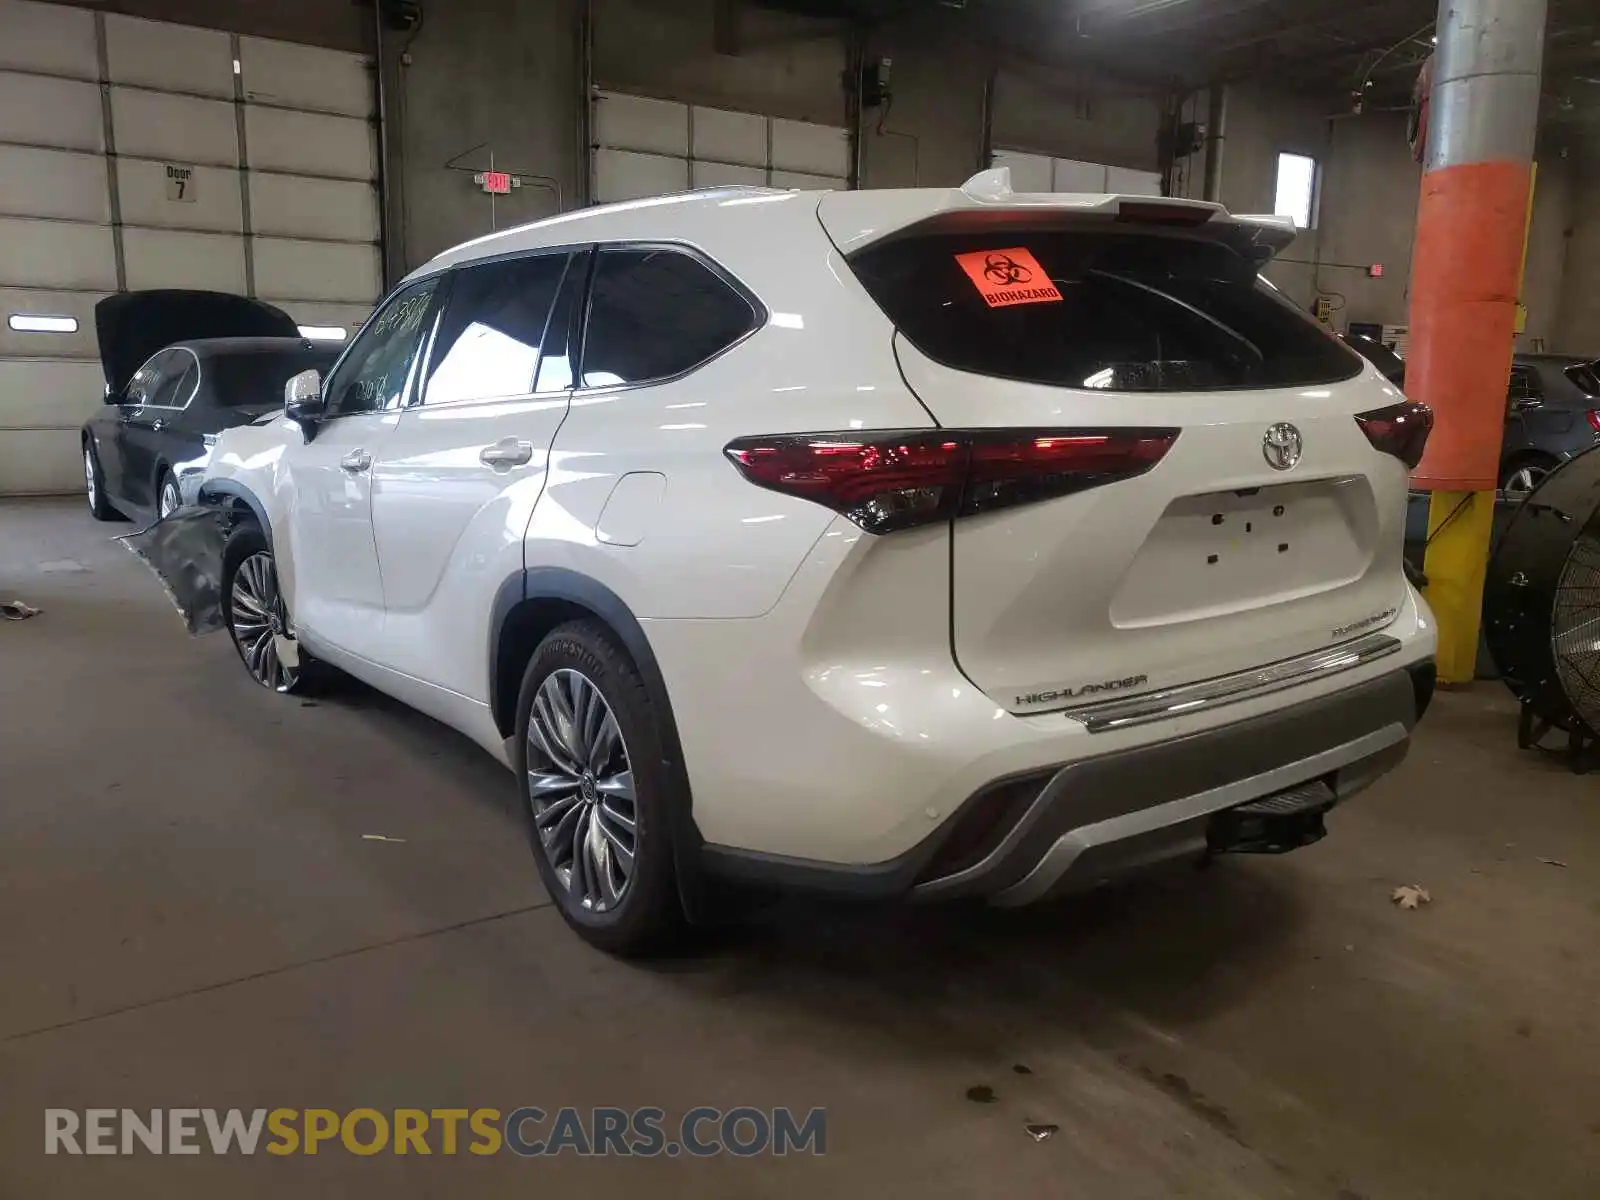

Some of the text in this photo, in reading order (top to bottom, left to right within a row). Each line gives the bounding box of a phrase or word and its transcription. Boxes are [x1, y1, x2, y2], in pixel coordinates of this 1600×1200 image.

[166, 165, 192, 180] Door
[175, 181, 185, 200] 7
[985, 287, 1060, 304] BIOHAZARD
[1015, 674, 1148, 705] HIGHLANDER
